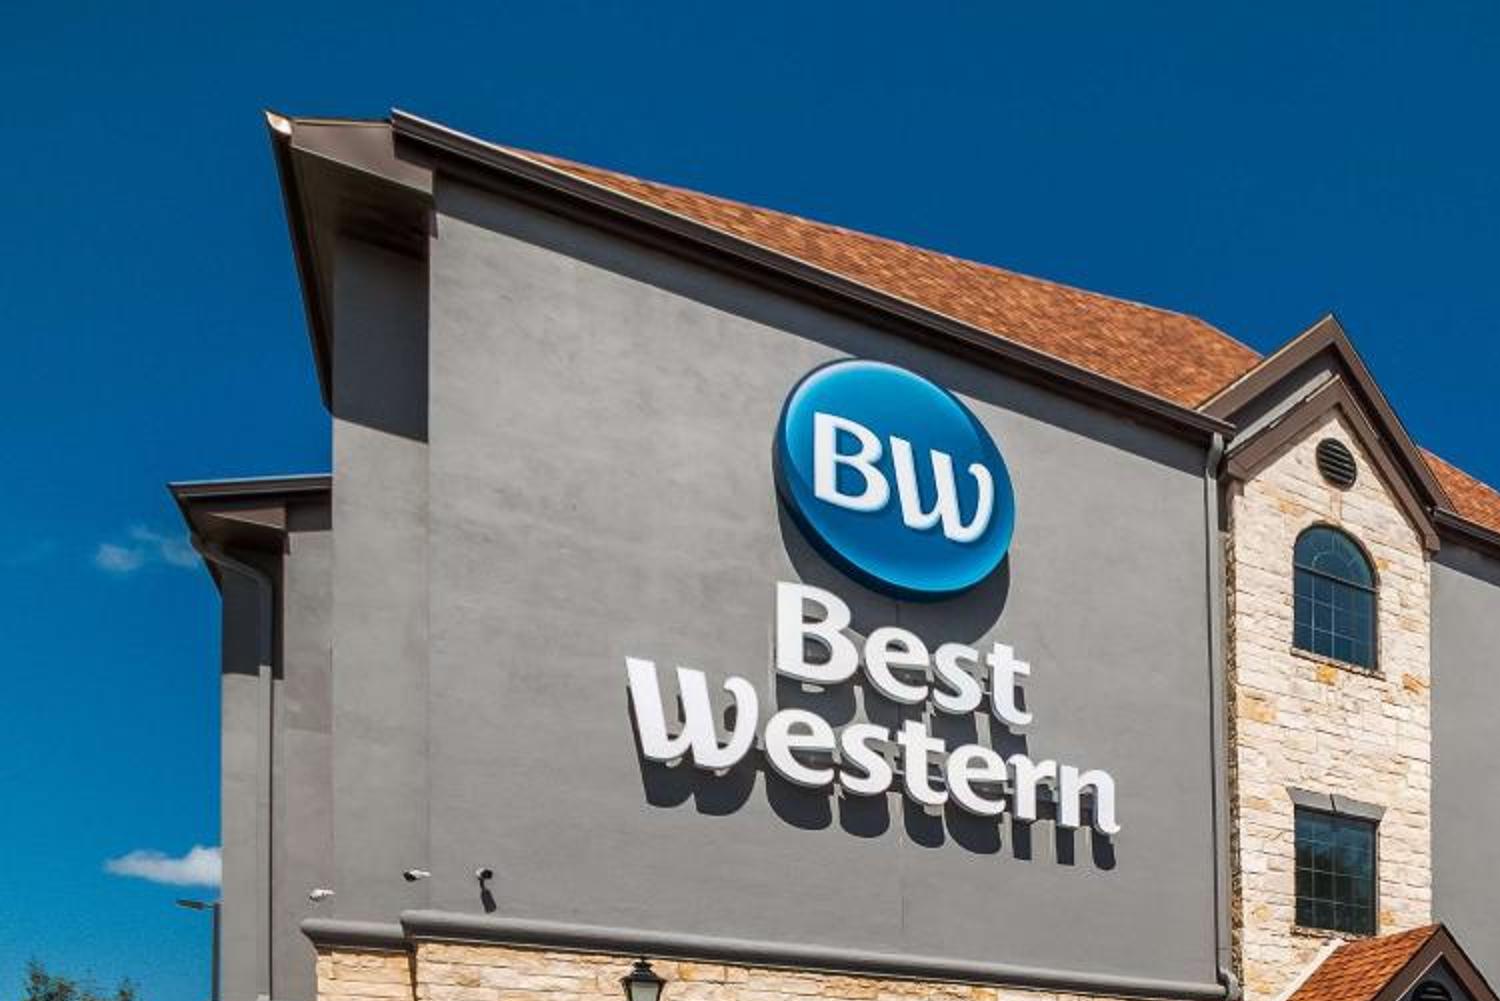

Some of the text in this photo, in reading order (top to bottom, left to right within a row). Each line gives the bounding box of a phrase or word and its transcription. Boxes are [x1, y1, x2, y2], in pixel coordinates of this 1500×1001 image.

[813, 412, 993, 543] BW
[776, 582, 1033, 725] Best
[625, 657, 1121, 834] Western
